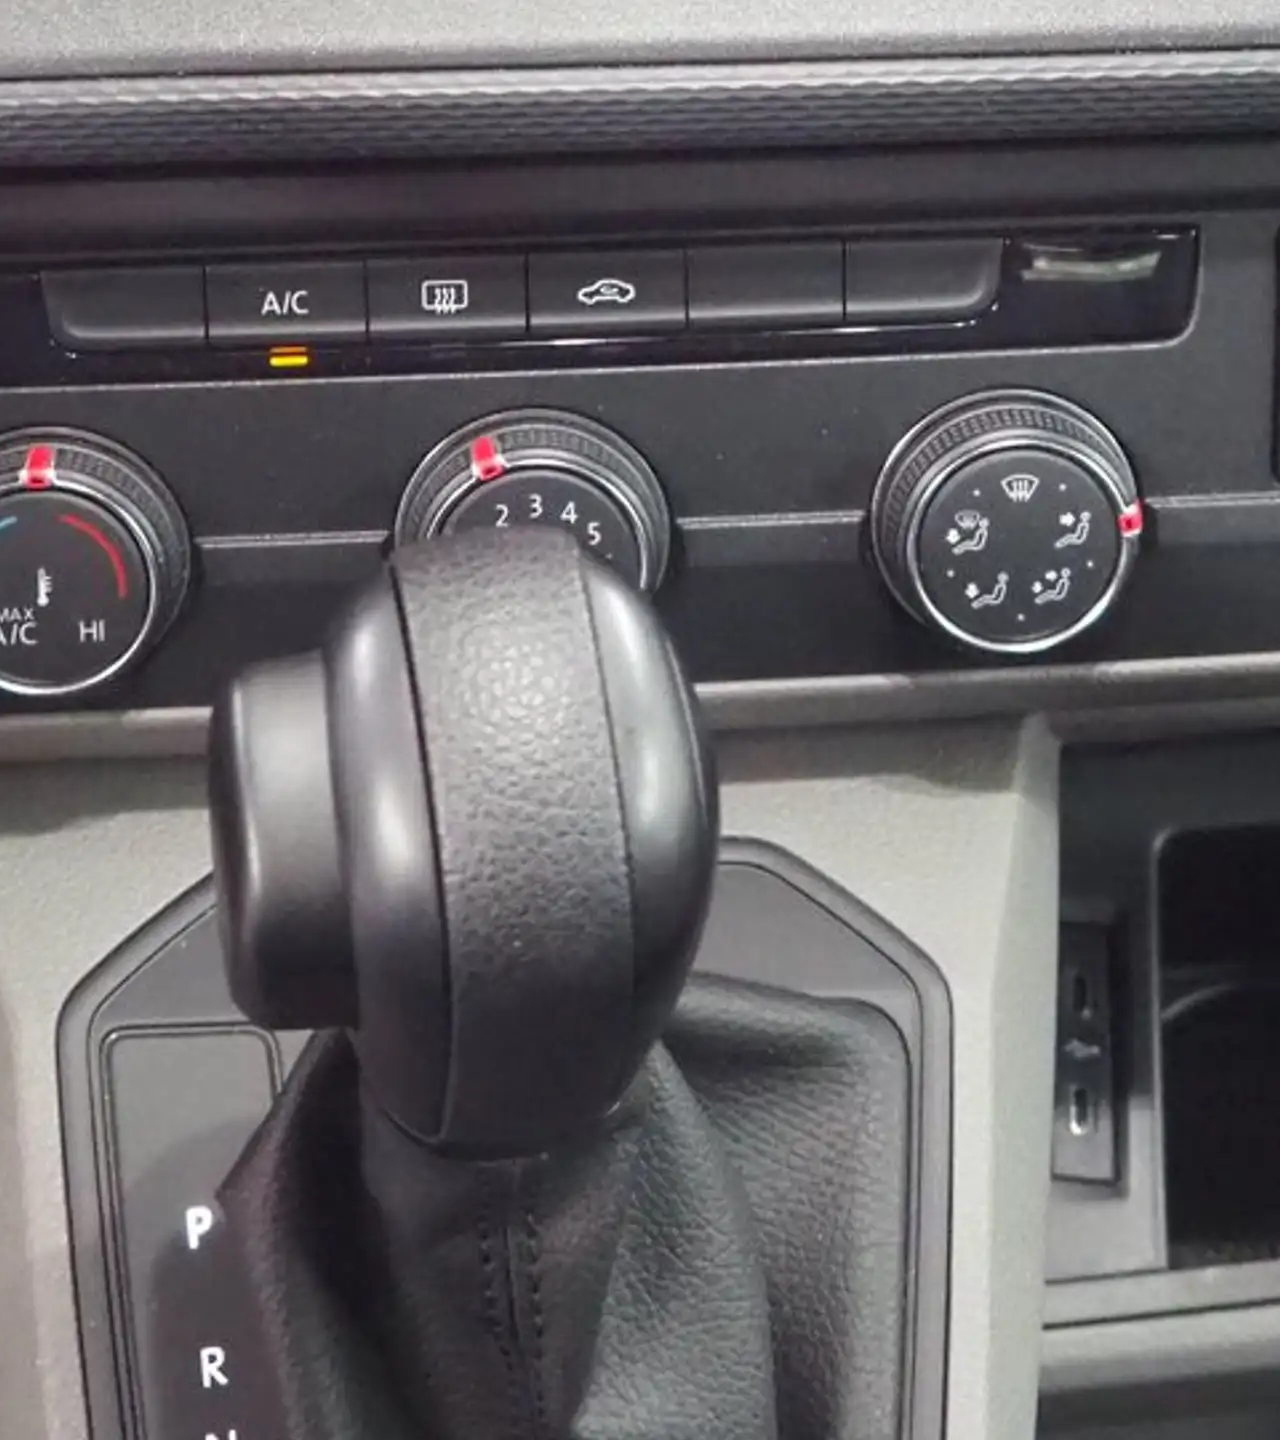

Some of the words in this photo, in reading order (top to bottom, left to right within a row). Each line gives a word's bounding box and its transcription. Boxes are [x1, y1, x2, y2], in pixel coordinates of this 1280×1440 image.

[261, 290, 309, 315] A/C
[495, 503, 509, 529] 2
[528, 493, 543, 519] 3
[559, 500, 579, 524] 4
[586, 521, 602, 546] 5
[79, 619, 105, 642] HI
[185, 1205, 214, 1250] P
[200, 1346, 229, 1388] R
